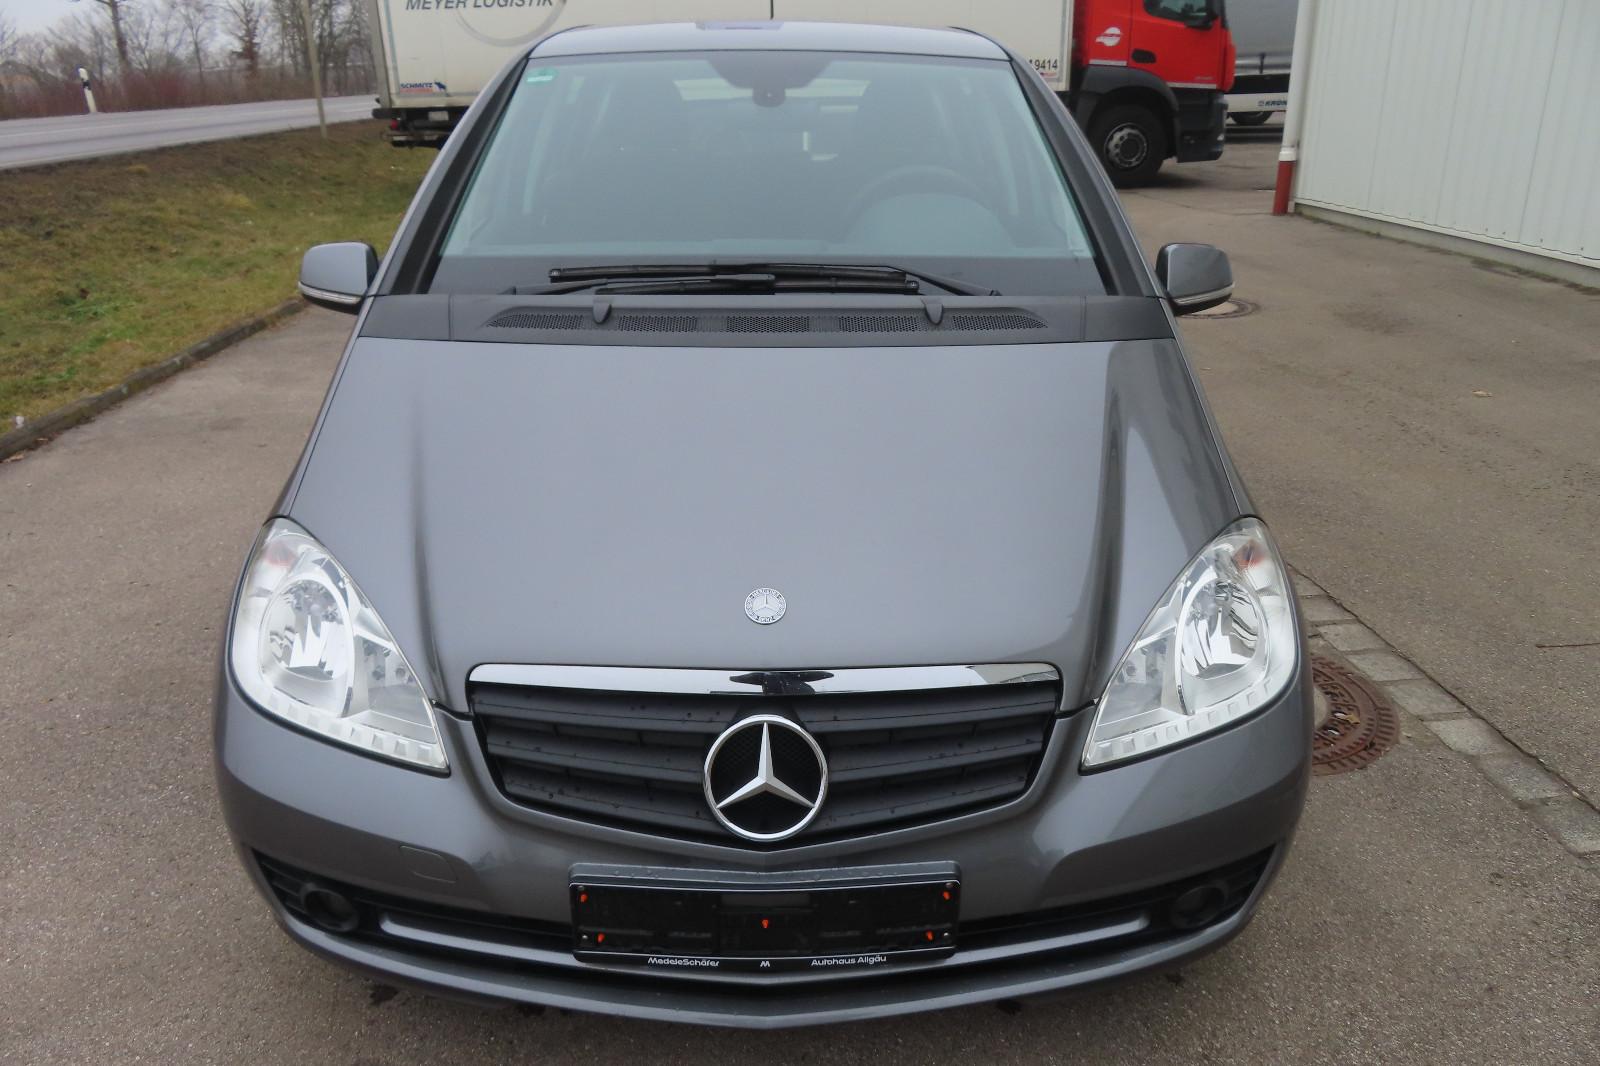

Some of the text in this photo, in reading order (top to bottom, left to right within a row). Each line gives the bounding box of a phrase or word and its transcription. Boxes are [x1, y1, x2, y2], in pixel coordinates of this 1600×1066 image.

[406, 0, 466, 10] MEYER
[811, 957, 856, 966] Autohaus
[857, 955, 887, 965] Allgäu
